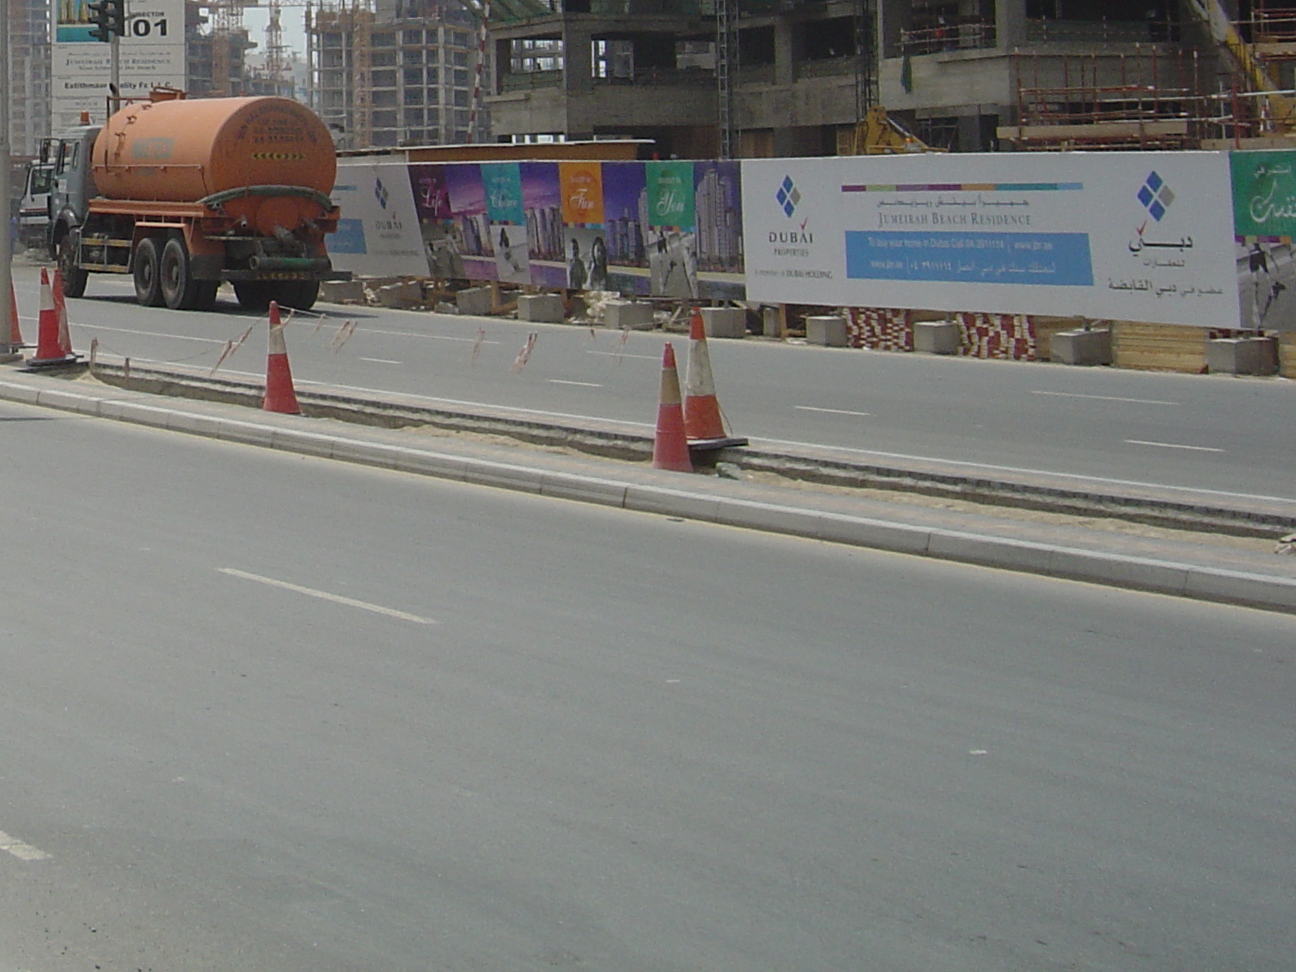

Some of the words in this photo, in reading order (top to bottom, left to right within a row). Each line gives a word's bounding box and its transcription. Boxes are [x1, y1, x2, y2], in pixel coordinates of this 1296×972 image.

[132, 18, 167, 37] 01
[878, 212, 928, 228] JUMEIRAH
[932, 212, 967, 225] BEACH
[970, 212, 1031, 226] RESIDENCE
[769, 231, 813, 244] DUBAI
[773, 248, 810, 258] PROPERTIES
